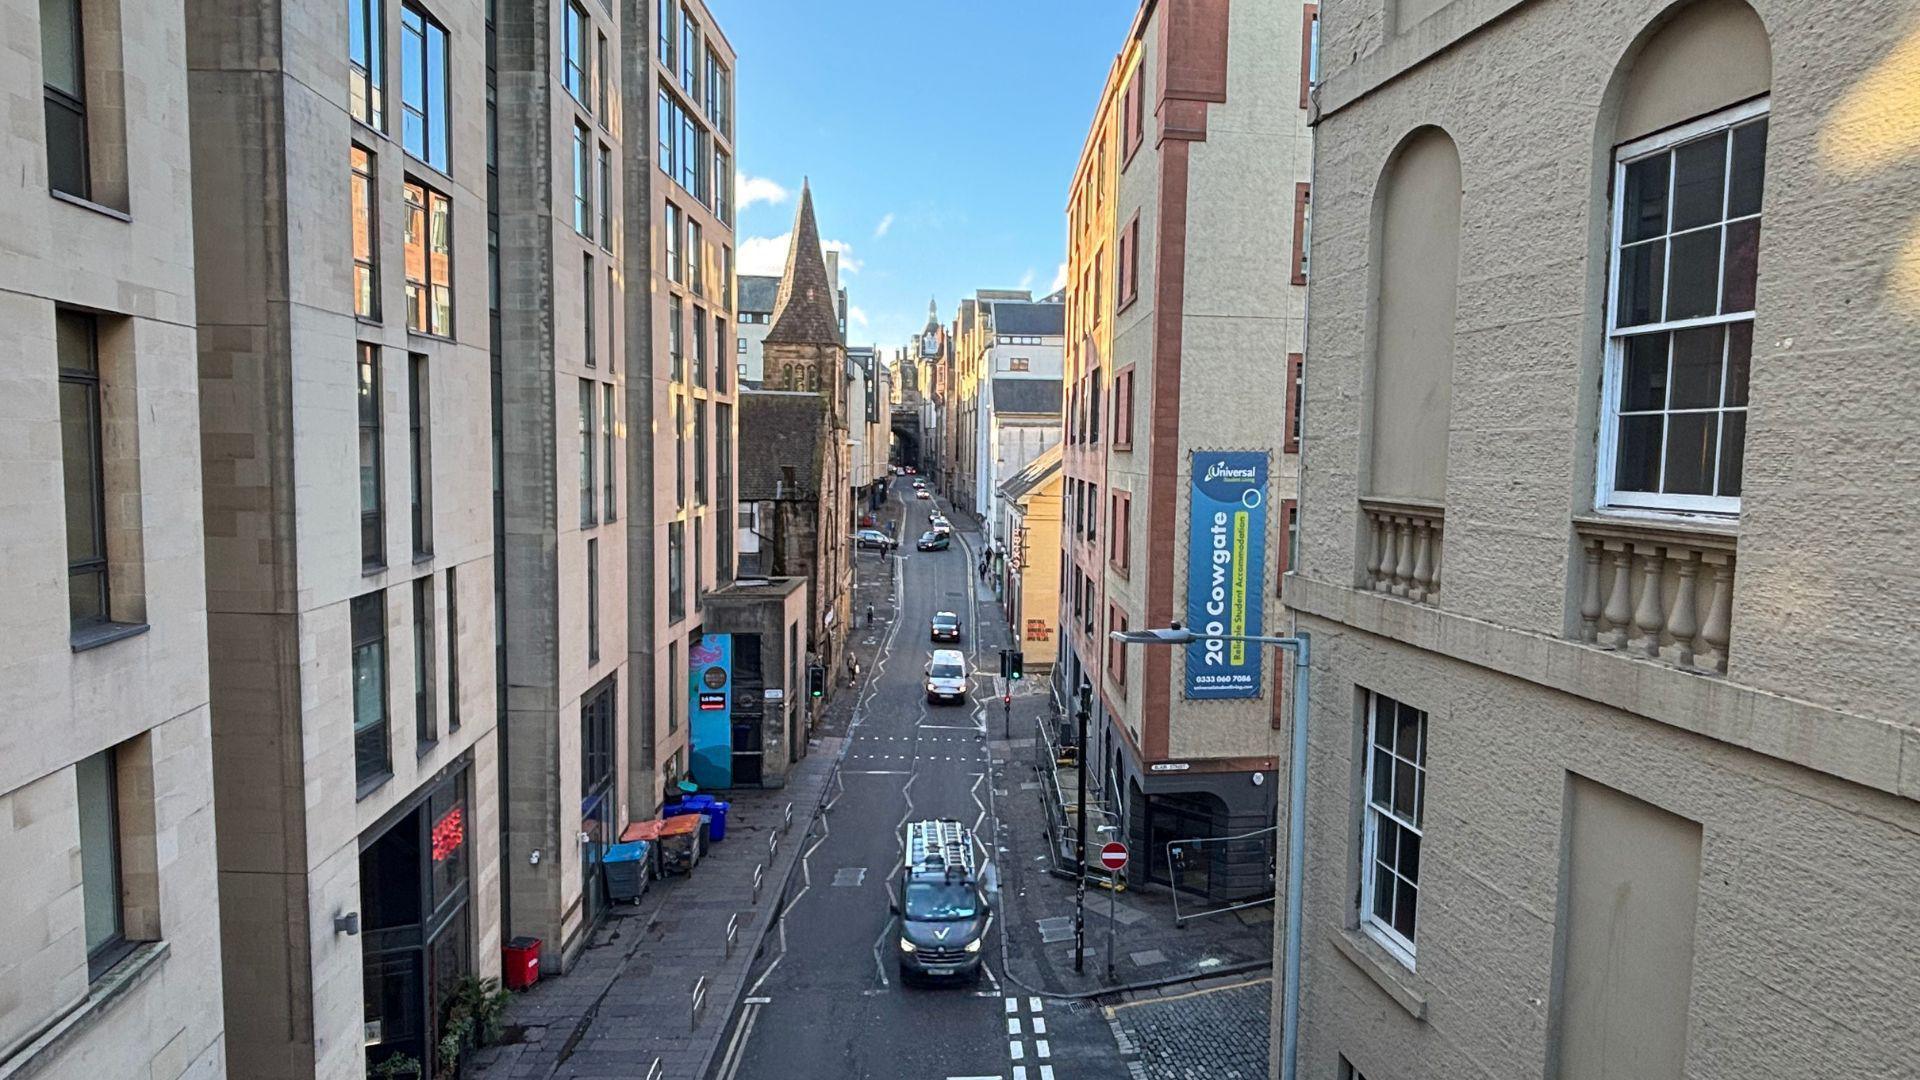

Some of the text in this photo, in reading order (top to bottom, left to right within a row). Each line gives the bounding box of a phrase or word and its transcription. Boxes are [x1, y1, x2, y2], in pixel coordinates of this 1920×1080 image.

[1212, 467, 1256, 477] Universal
[1235, 516, 1246, 588] Accommodation
[1205, 512, 1231, 665] 200 Cowgate
[1235, 590, 1244, 622] Student
